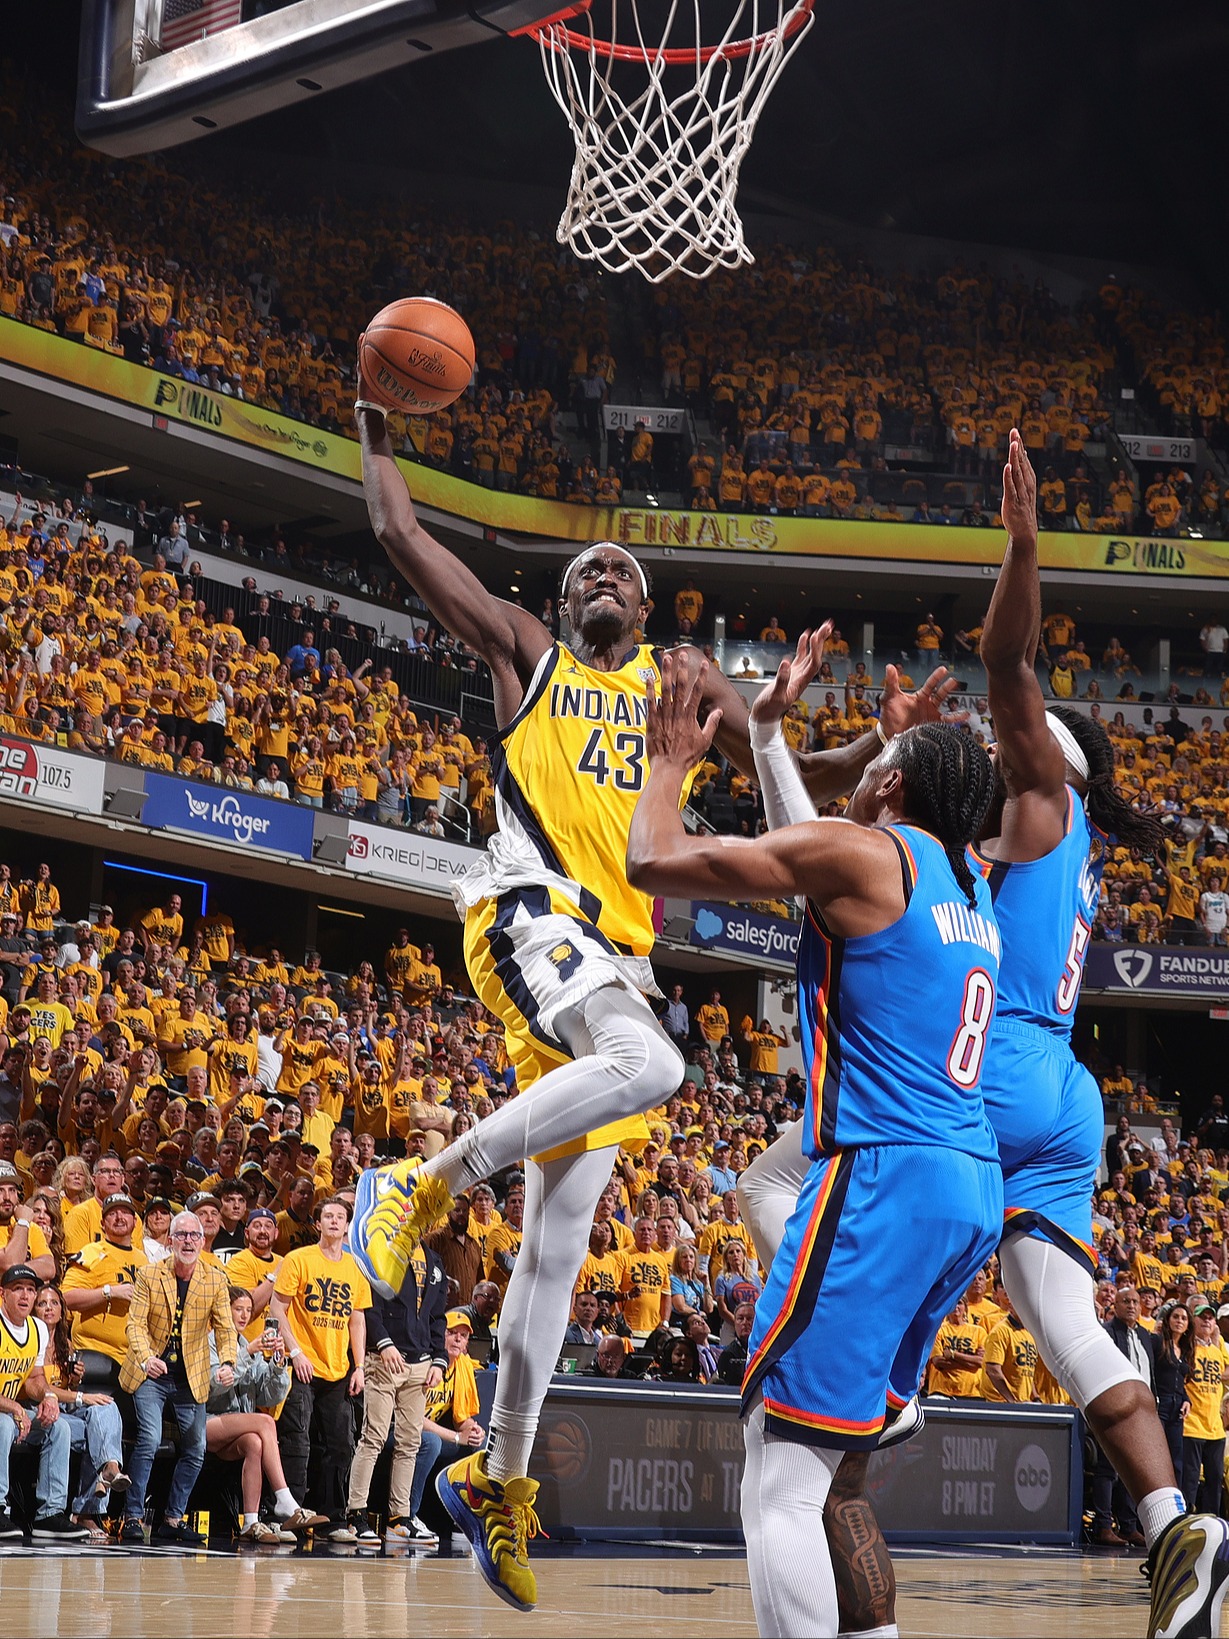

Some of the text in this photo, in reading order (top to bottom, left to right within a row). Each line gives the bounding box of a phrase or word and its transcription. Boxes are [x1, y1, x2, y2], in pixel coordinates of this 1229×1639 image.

[610, 412, 628, 426] 211
[657, 414, 679, 429] 212
[1170, 444, 1191, 458] 213
[618, 509, 778, 550] FINALS
[550, 683, 650, 727] INDIAN
[576, 728, 647, 791] 43
[42, 765, 71, 789] 107.5
[211, 795, 271, 843] Kroger
[371, 843, 471, 876] KRIEG DEVA
[726, 919, 799, 954] salesforc
[1056, 912, 1092, 1014] 5
[1160, 973, 1198, 985] SPORTS
[30, 1018, 57, 1030] CERS
[36, 1010, 55, 1020] YES
[945, 966, 995, 1090] 8
[637, 1262, 659, 1276] YES
[316, 1277, 351, 1300] YES
[312, 1316, 328, 1328] 2025
[946, 1336, 972, 1351] YES
[1196, 1357, 1220, 1373] YES
[645, 1418, 681, 1448] GAME
[684, 1419, 692, 1449] 7
[941, 1436, 998, 1472] SUNDAY
[607, 1458, 694, 1512] PACERS
[701, 1473, 715, 1503] AT
[1017, 1464, 1050, 1488] abc
[942, 1480, 997, 1516] 8 PM ET
